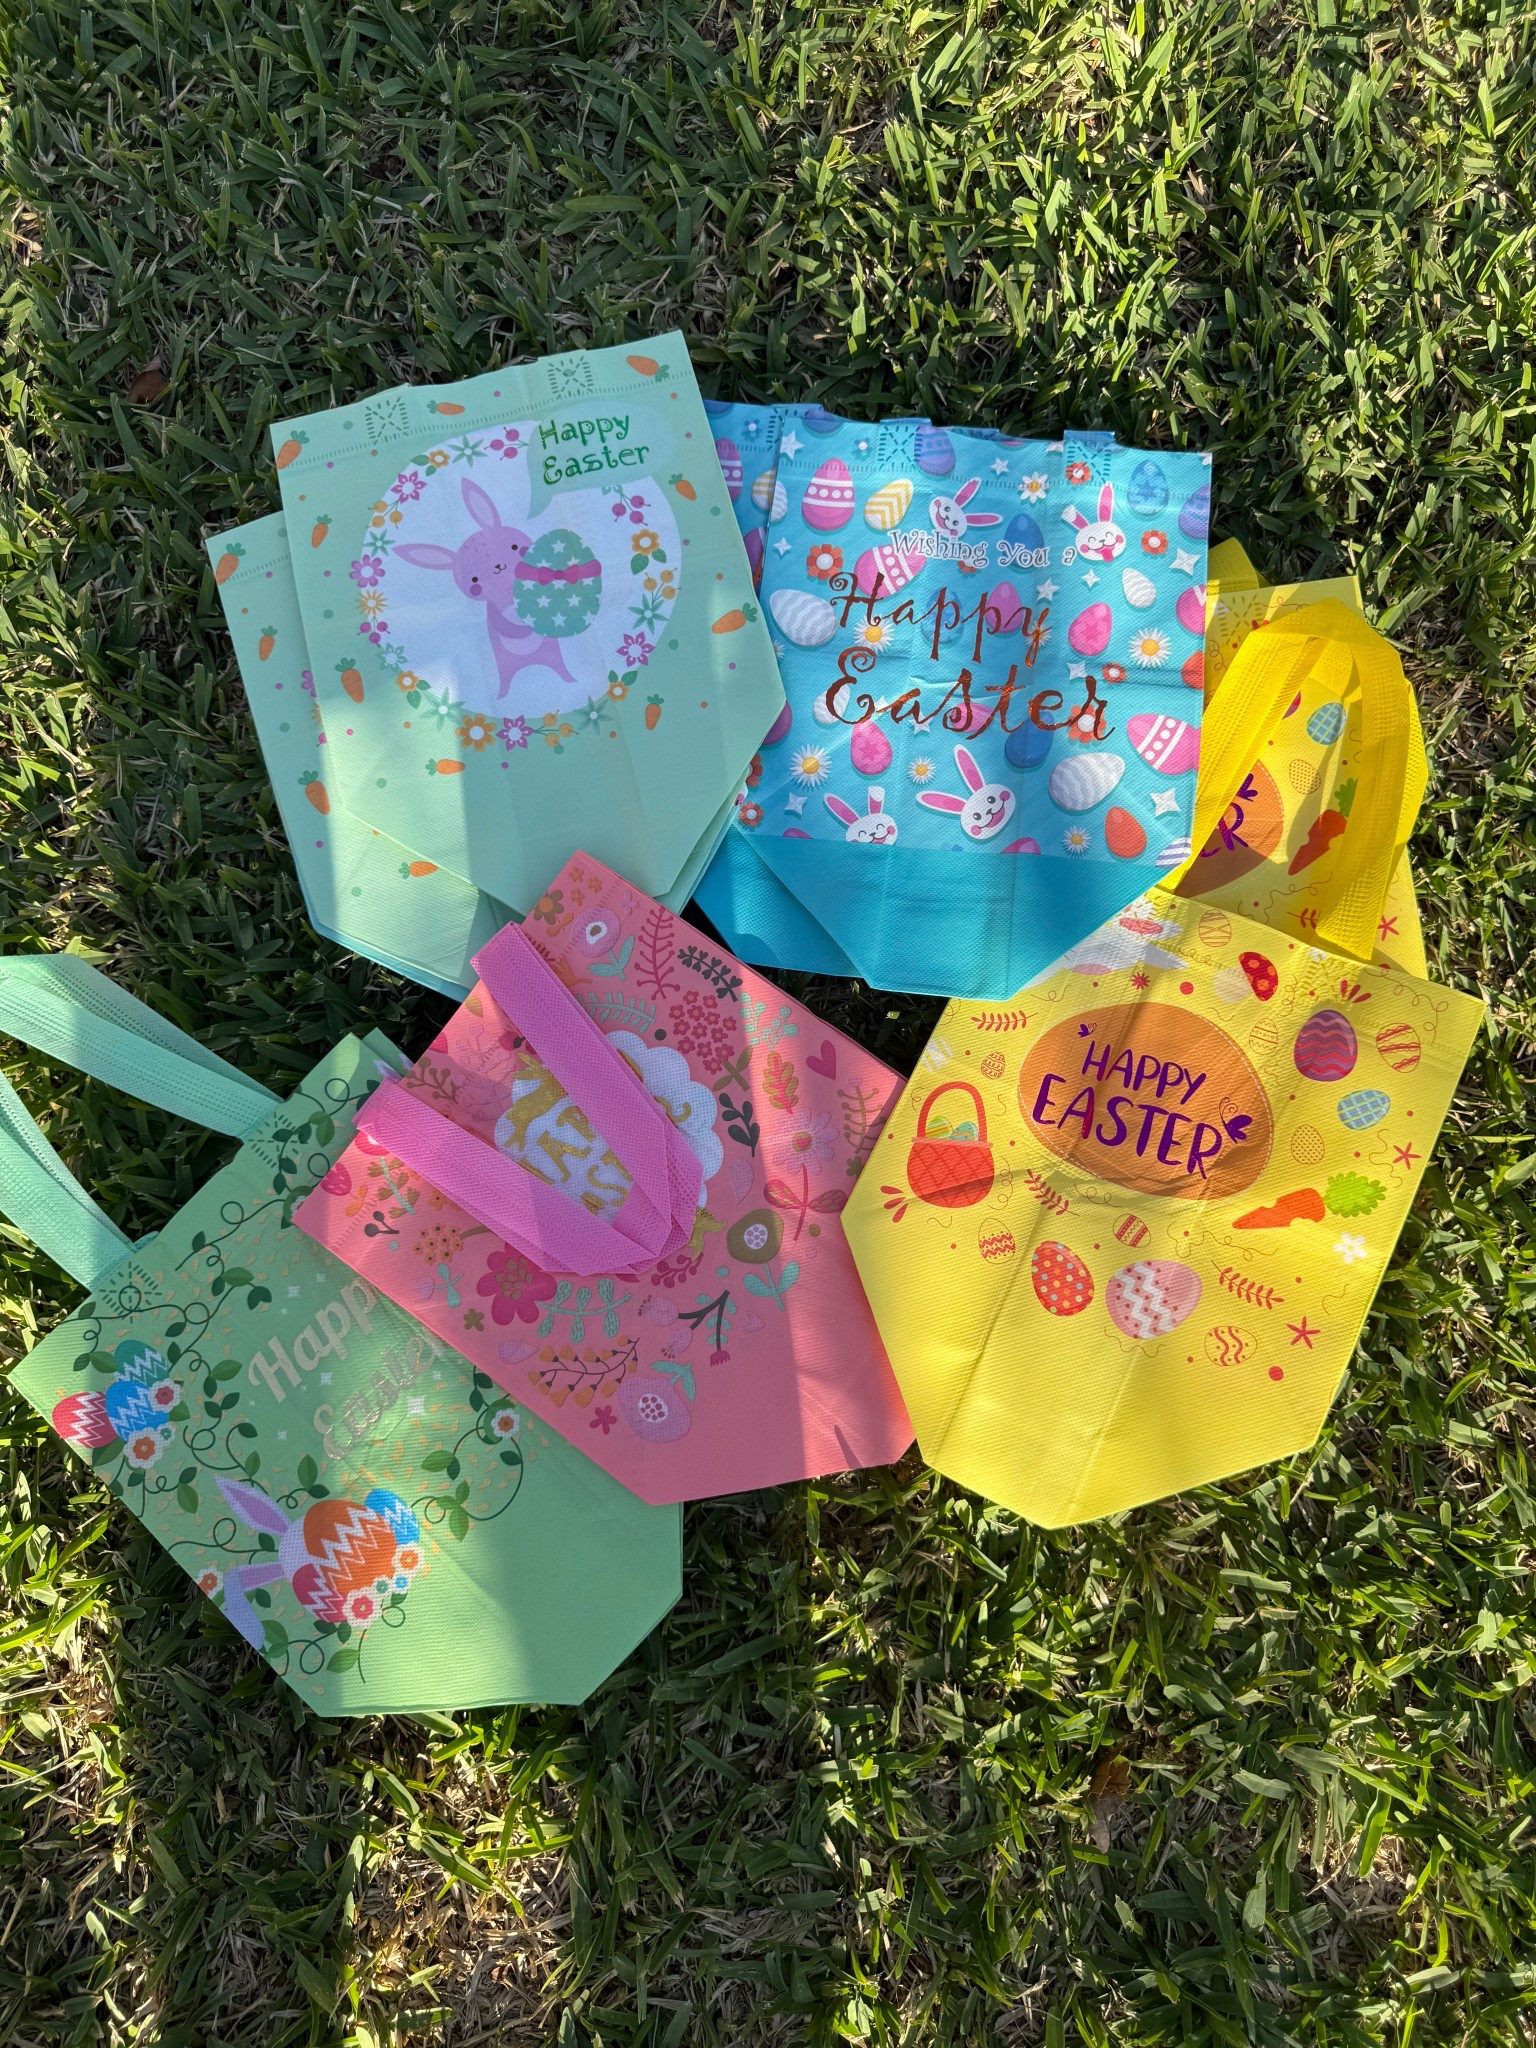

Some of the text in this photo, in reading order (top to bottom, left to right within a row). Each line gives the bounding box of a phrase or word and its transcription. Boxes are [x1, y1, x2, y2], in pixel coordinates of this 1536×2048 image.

[539, 415, 629, 449] Happy
[543, 446, 650, 485] Easter
[889, 529, 1078, 569] Wishing You a
[829, 572, 1052, 667] Happy
[825, 646, 1116, 741] Easter
[1081, 1040, 1207, 1105] HAPPY
[1032, 1073, 1223, 1180] EASTER
[248, 1277, 378, 1403] Happ
